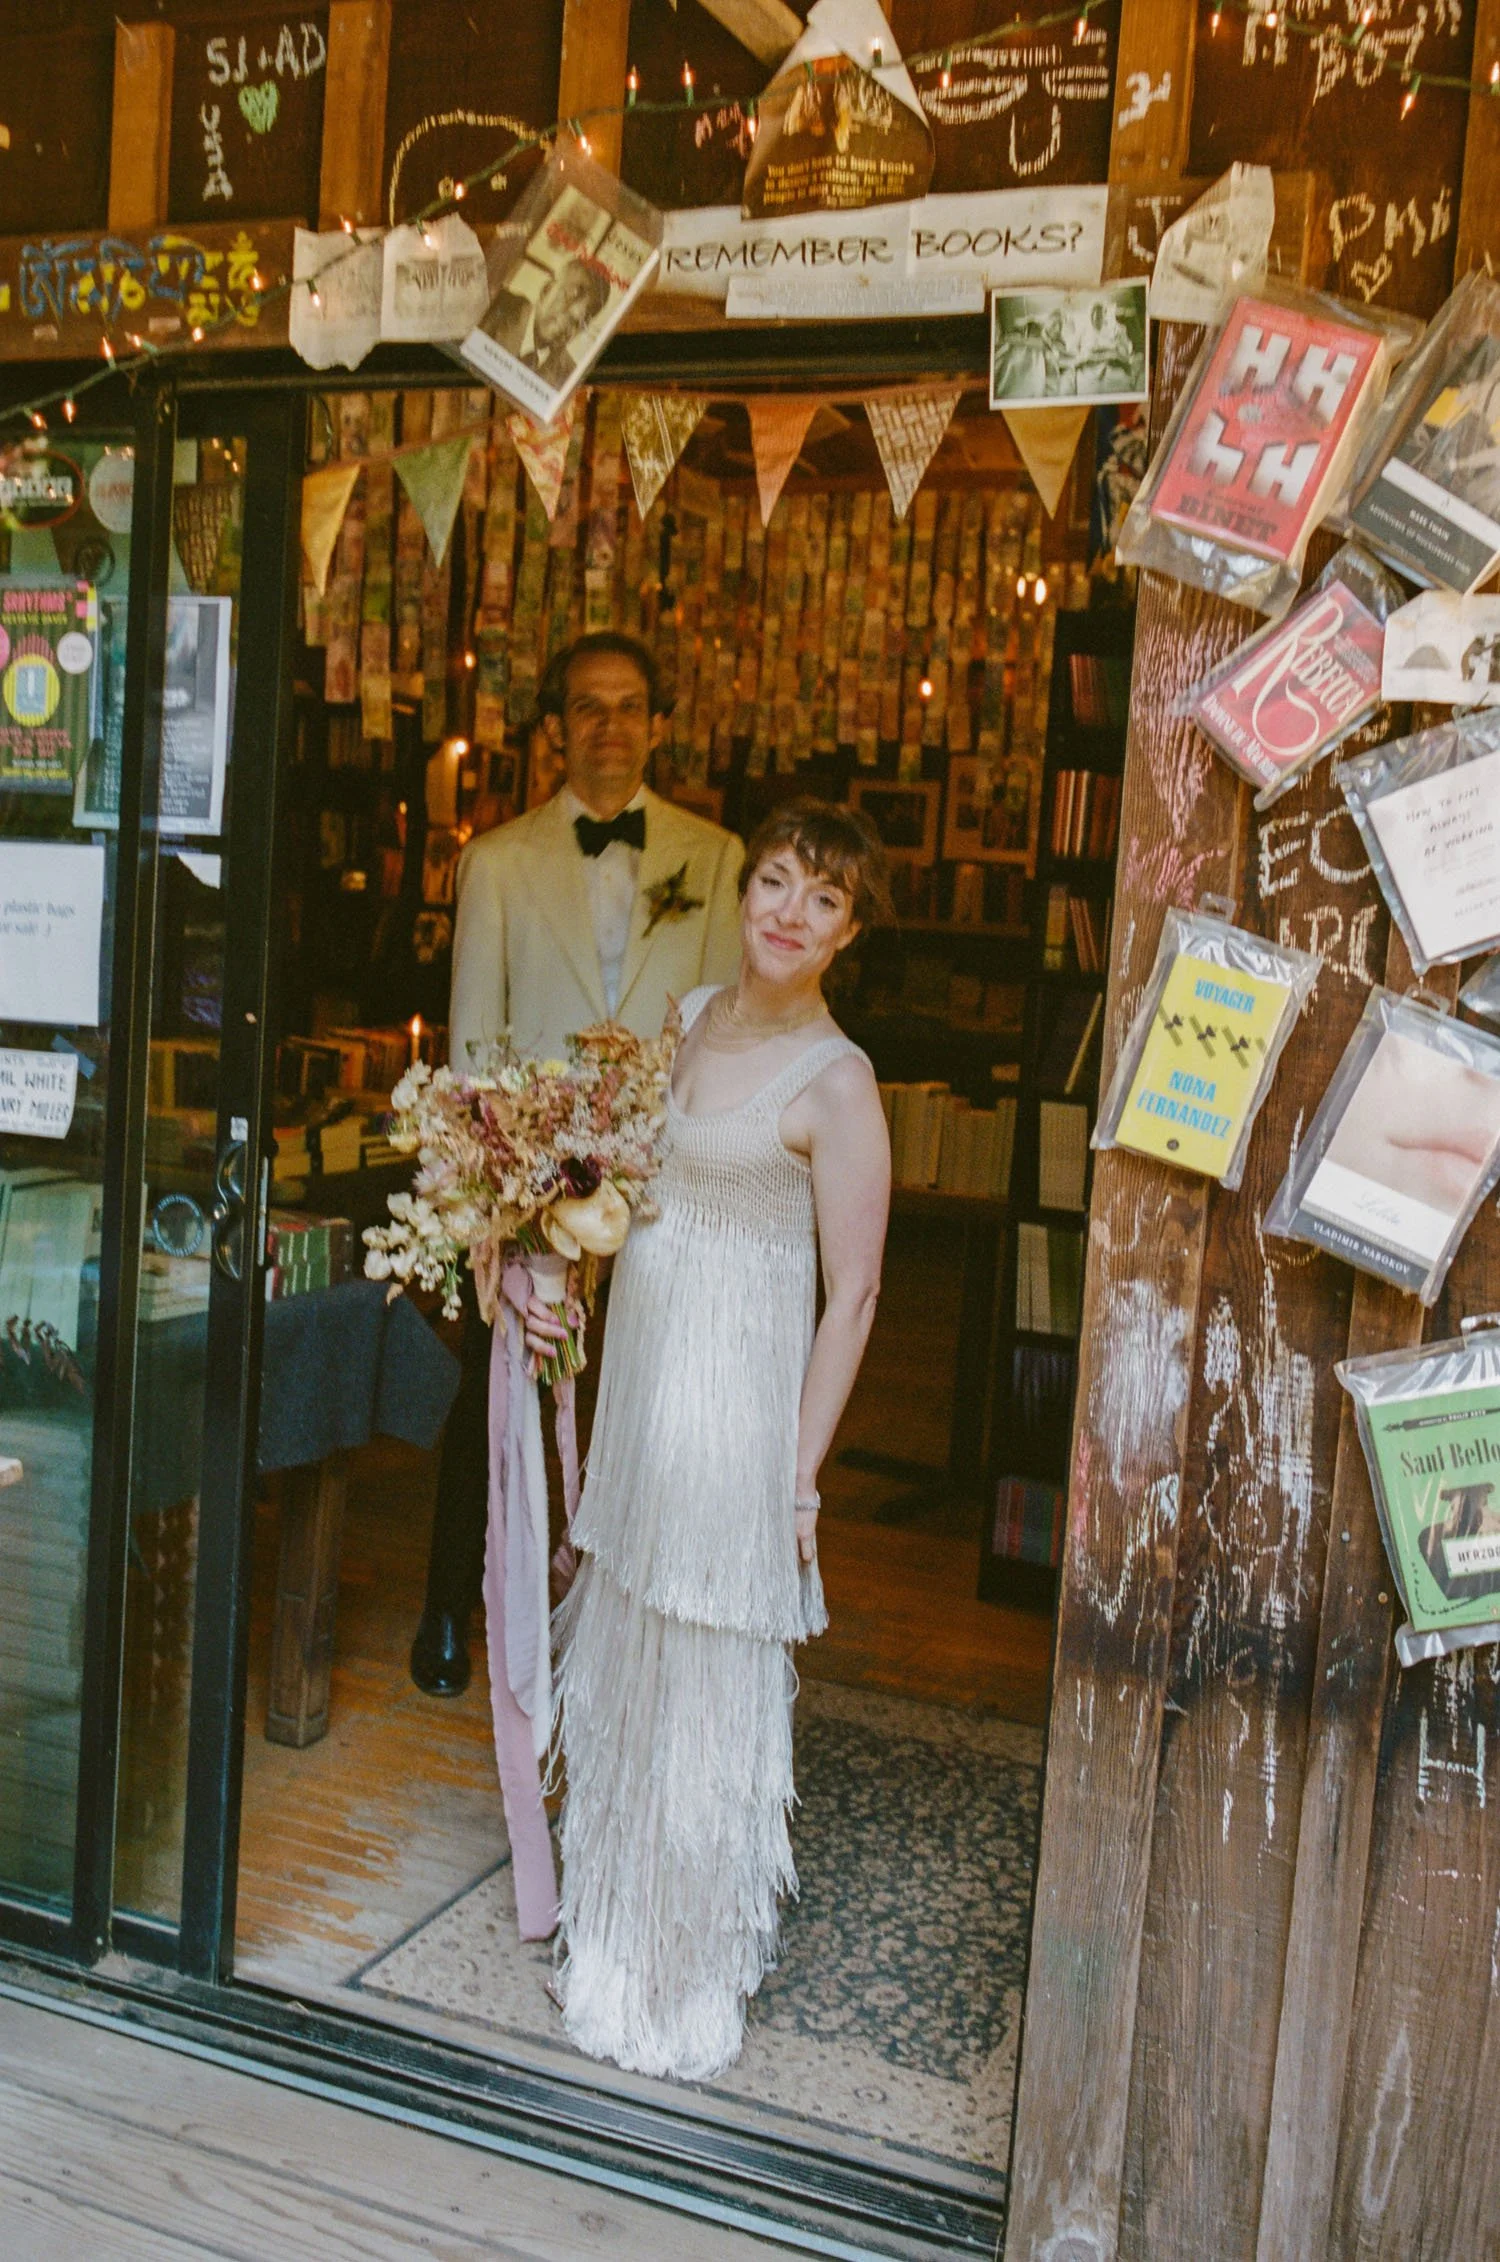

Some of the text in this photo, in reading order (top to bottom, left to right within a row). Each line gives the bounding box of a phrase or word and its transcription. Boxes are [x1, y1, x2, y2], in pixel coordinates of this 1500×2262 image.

[666, 234, 895, 274] REMEMBER
[914, 220, 1084, 259] BOOKS?
[1194, 978, 1256, 1015] VOYAGER
[24, 1071, 67, 1092] WHITE
[1168, 1069, 1217, 1104] NONA
[1313, 1220, 1360, 1253] VLADIMIR
[1361, 1243, 1412, 1276] NABOKOV
[1400, 1444, 1446, 1478] Saul
